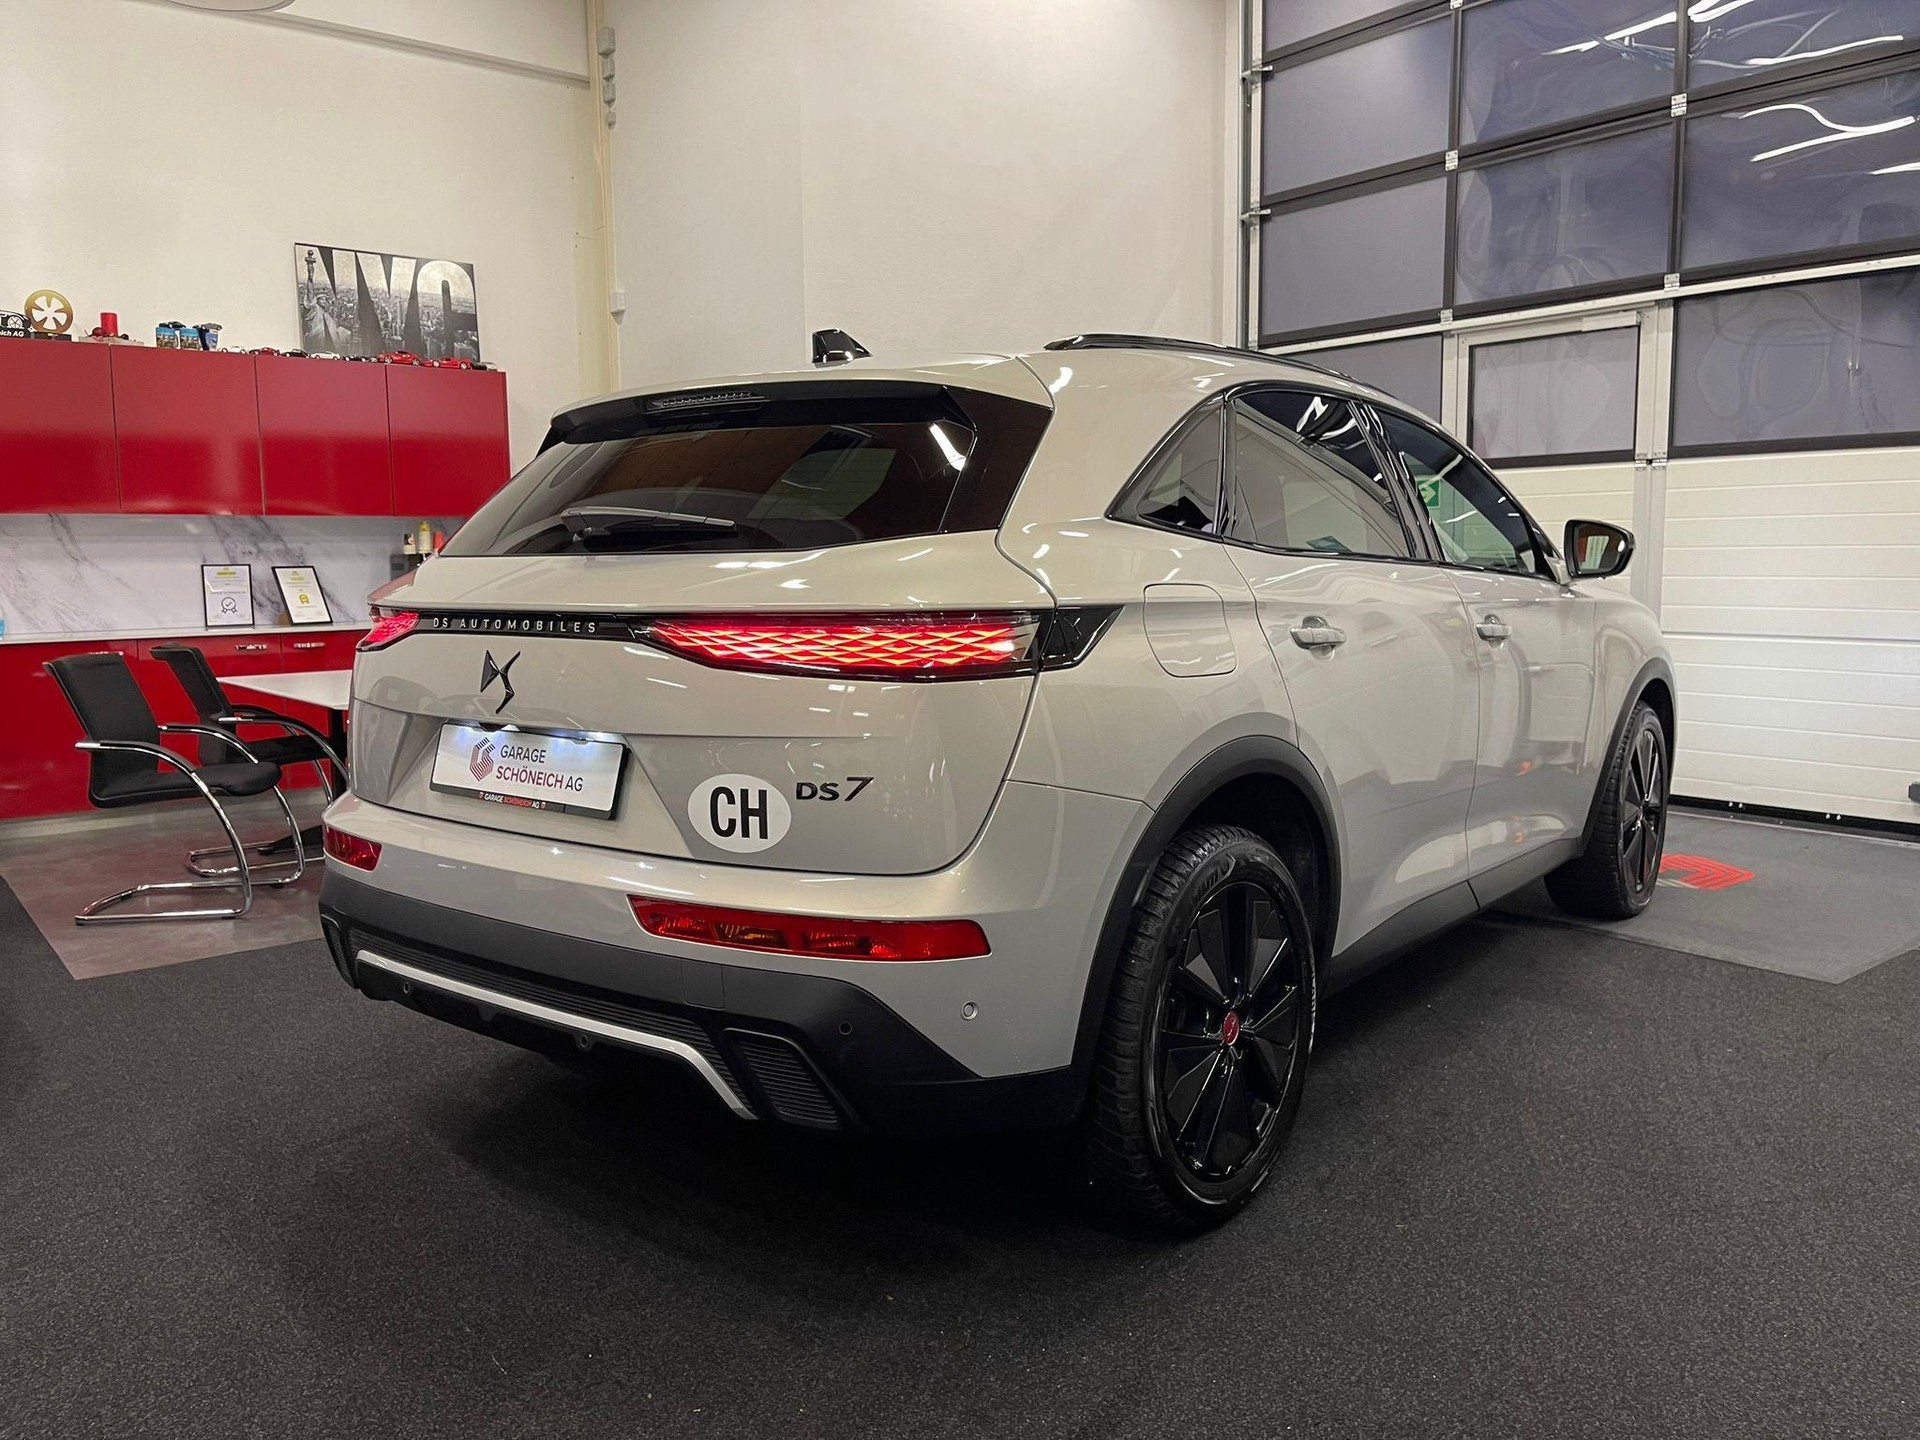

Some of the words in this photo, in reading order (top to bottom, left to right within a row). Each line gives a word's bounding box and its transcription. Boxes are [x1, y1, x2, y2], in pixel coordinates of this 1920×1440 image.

[295, 243, 480, 362] NYC
[13, 330, 25, 338] AG
[433, 617, 449, 628] DS
[459, 619, 596, 633] AUTOMOBILES
[500, 744, 547, 764] GARAGE
[496, 764, 564, 789] SCHÖNEICH
[565, 776, 584, 792] AG
[484, 793, 504, 804] GARAGE
[531, 801, 540, 809] AG
[709, 786, 769, 840] CH
